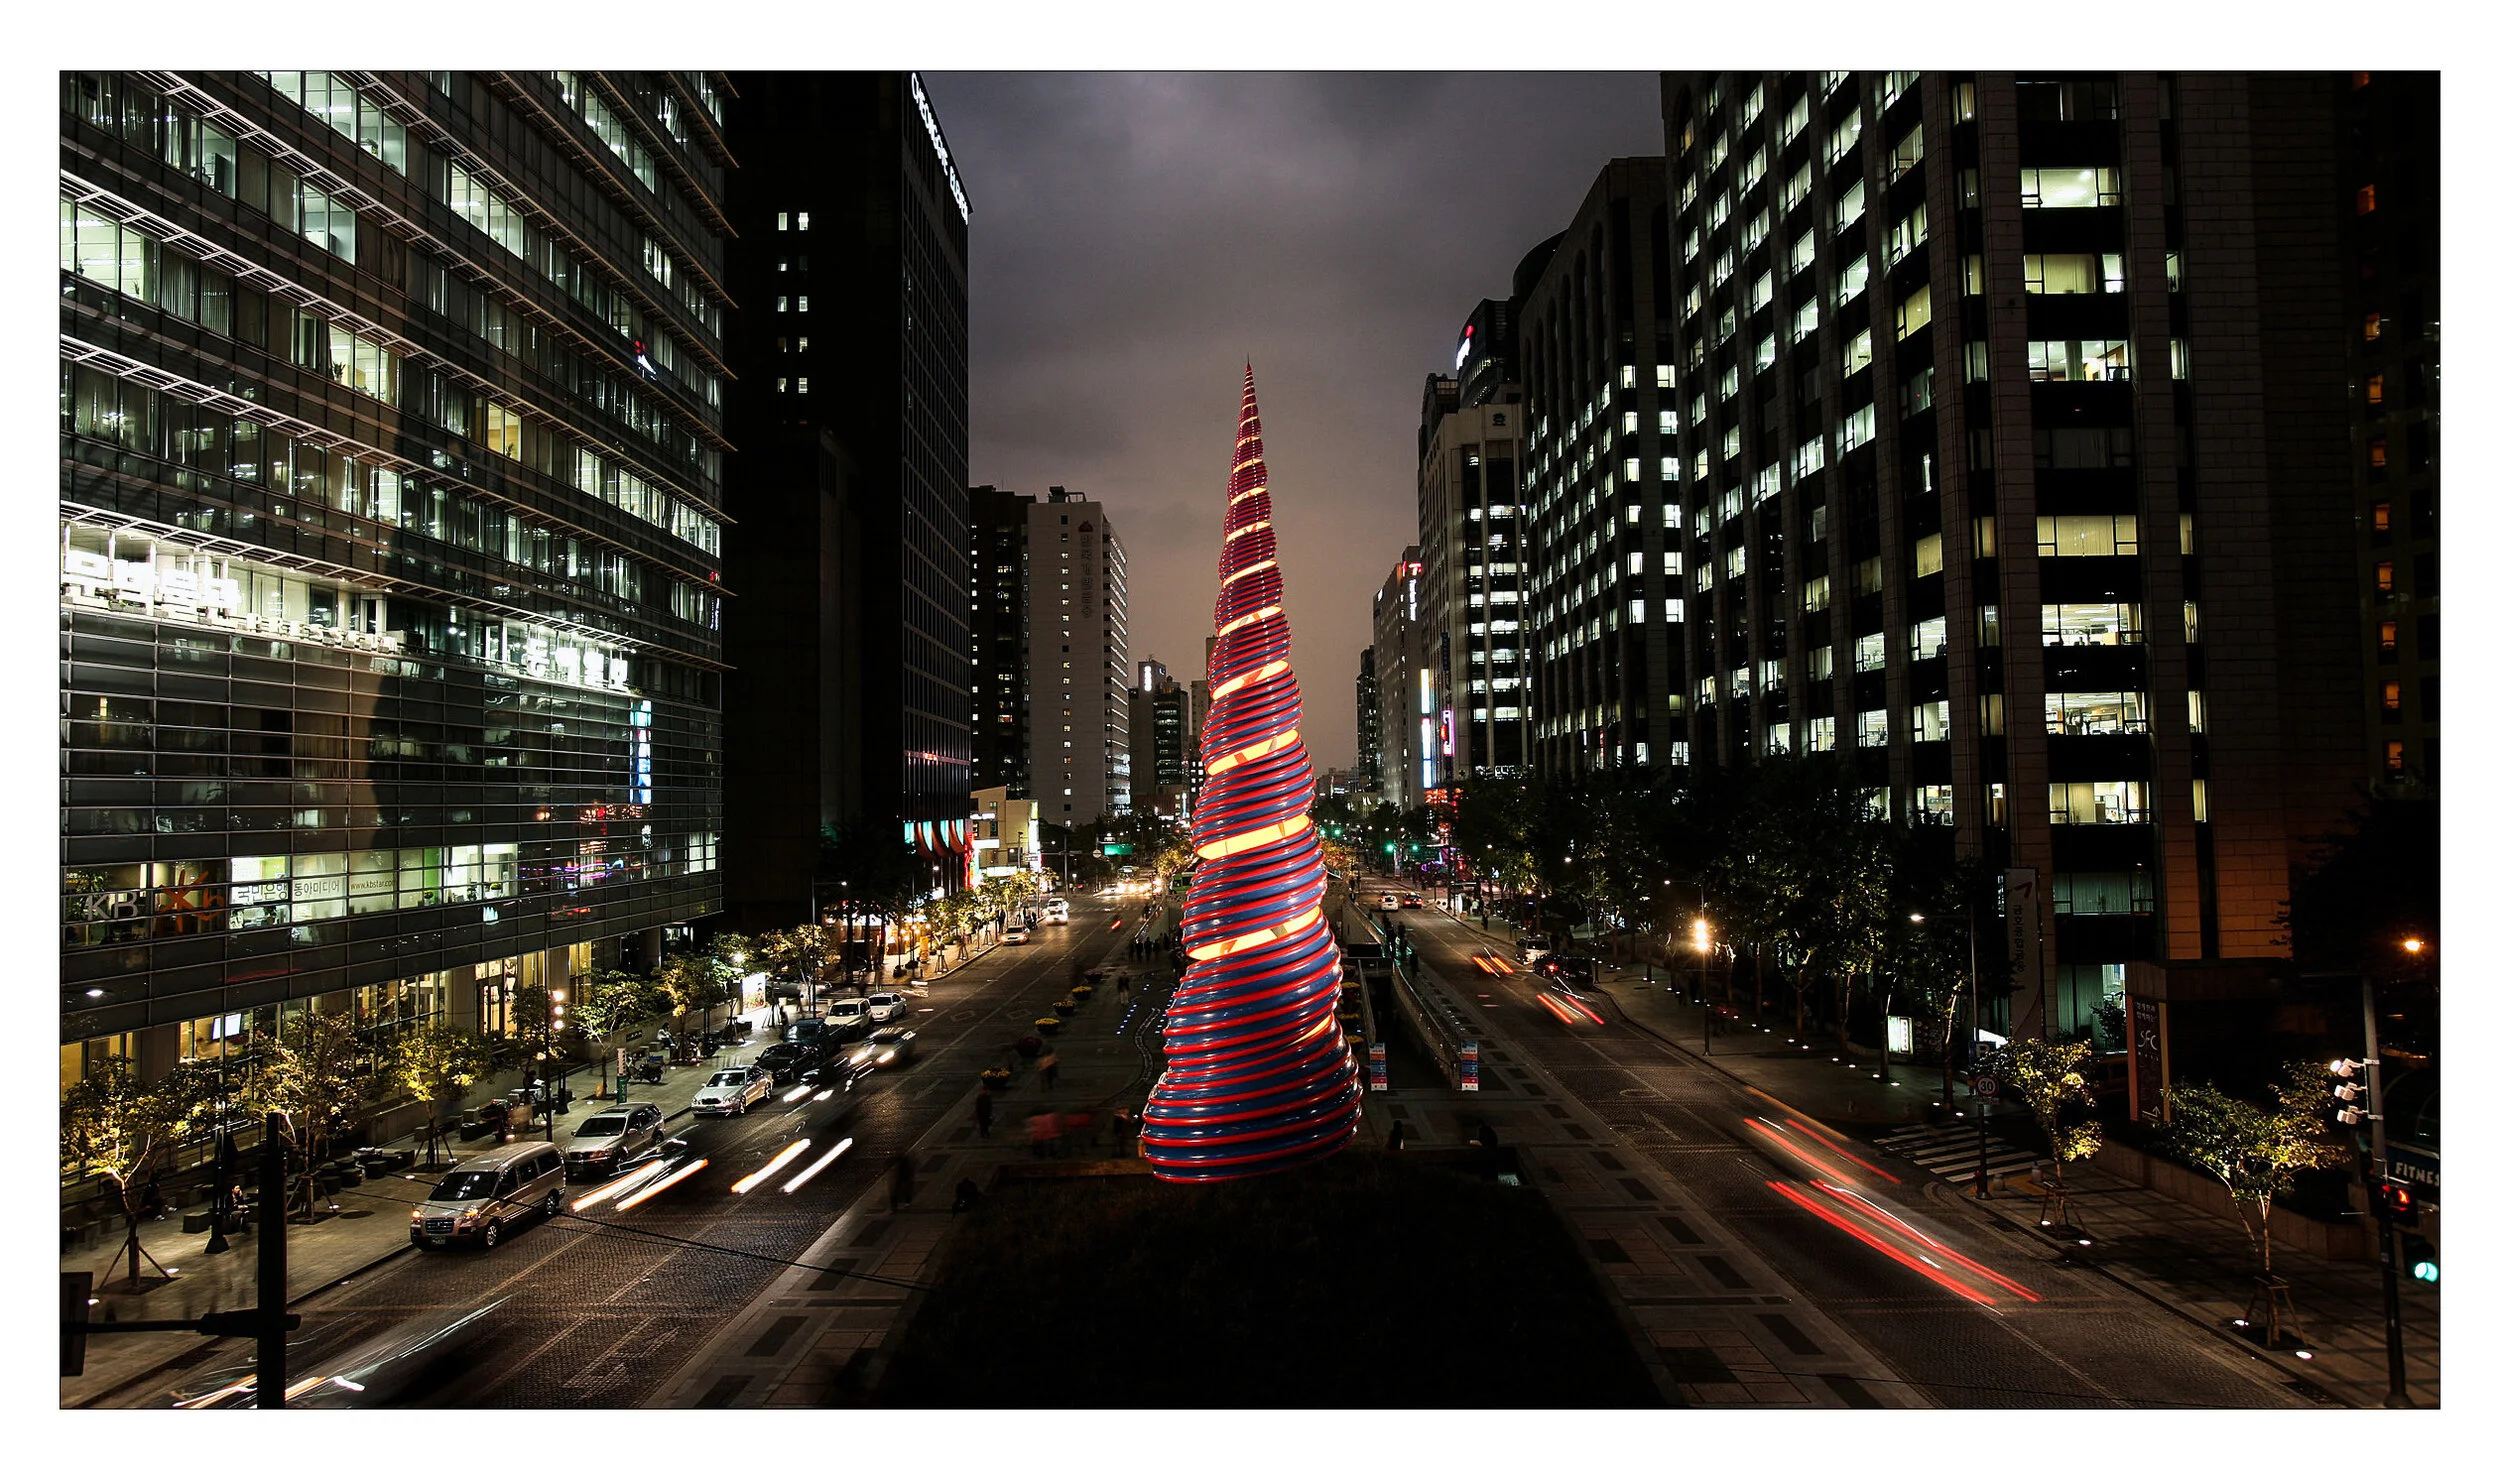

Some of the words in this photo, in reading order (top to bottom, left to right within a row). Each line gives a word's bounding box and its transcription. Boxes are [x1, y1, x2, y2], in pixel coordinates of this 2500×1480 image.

[238, 874, 288, 902] 국민은행
[293, 880, 340, 897] 동아미디어
[87, 891, 139, 922] KB
[1976, 1043, 1990, 1058] P
[1980, 1081, 1993, 1091] 30
